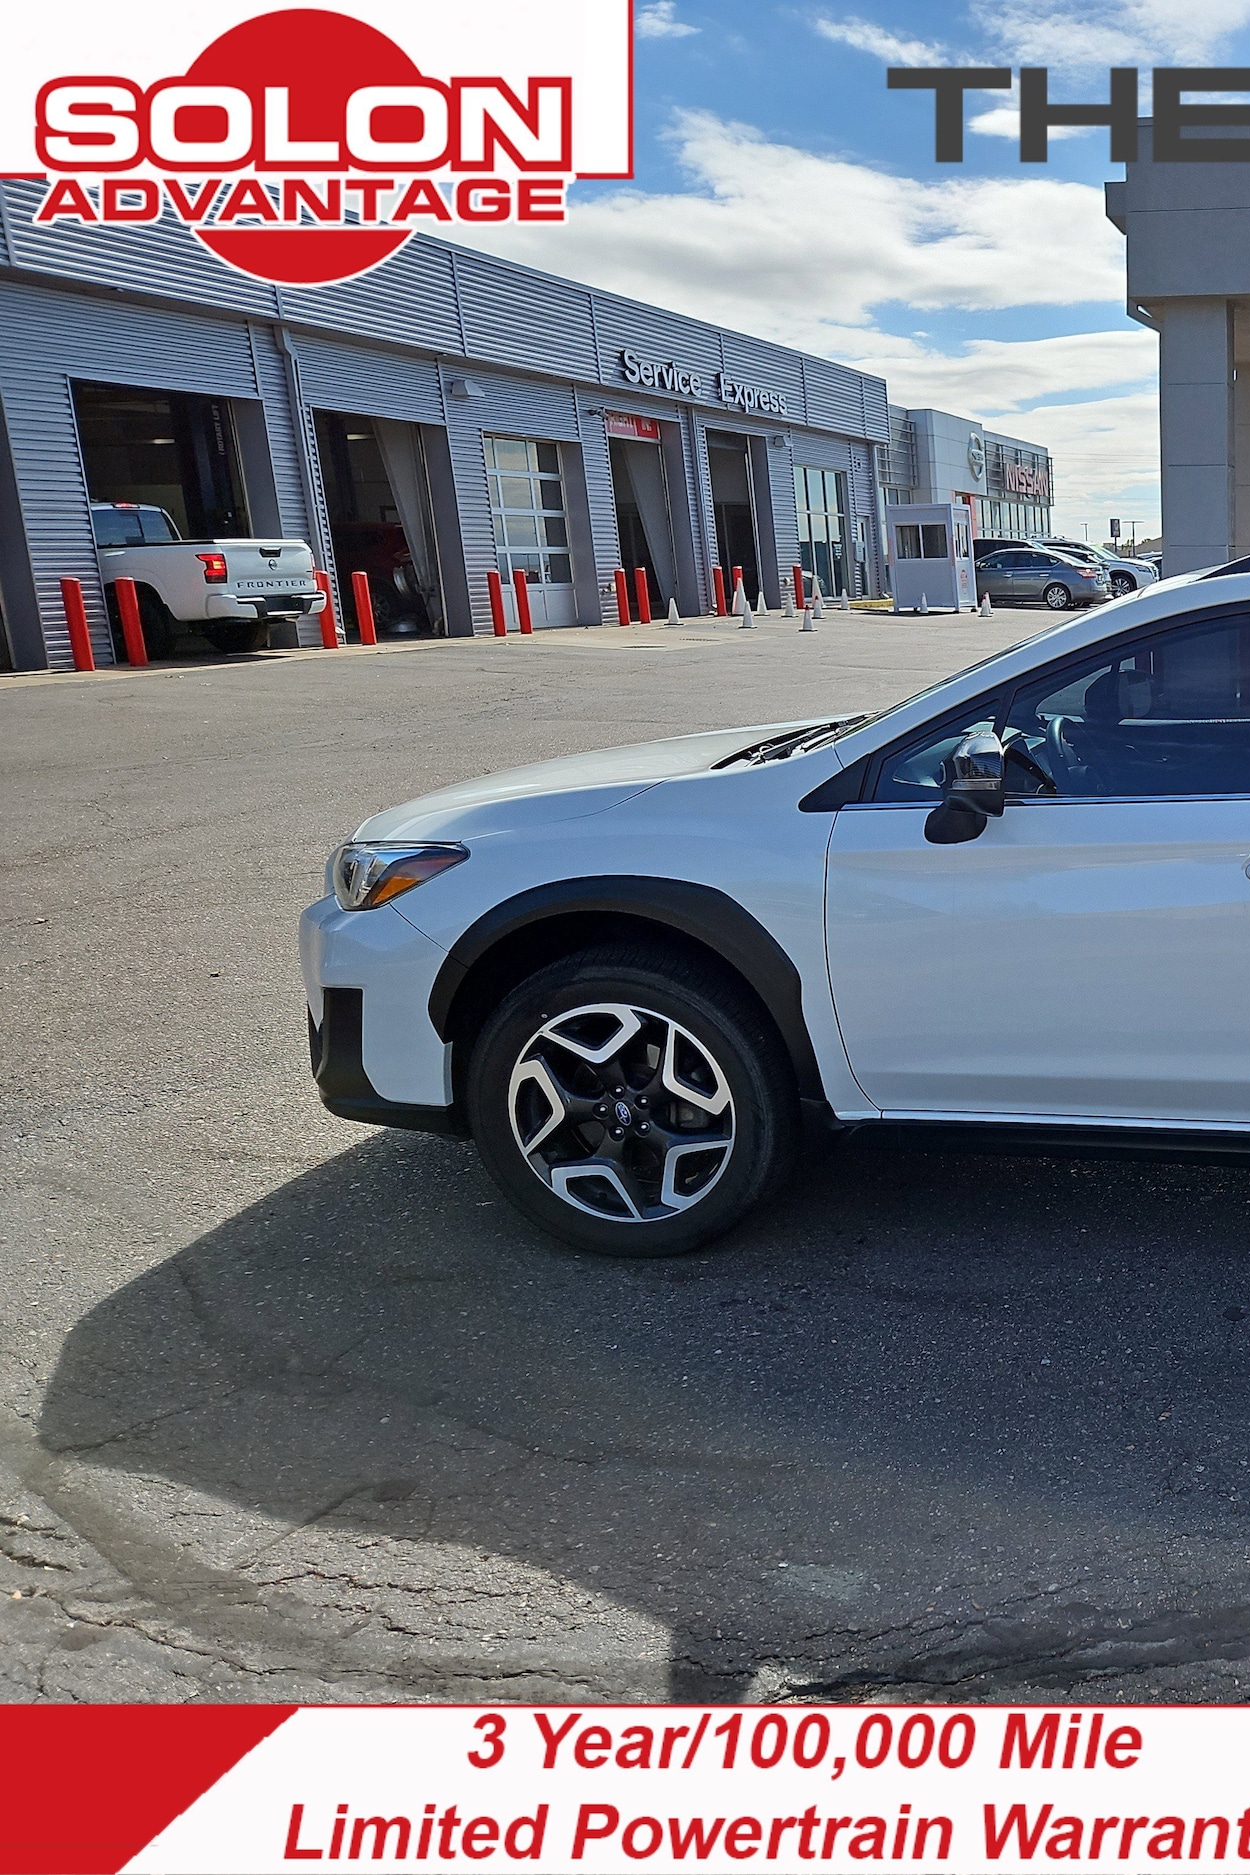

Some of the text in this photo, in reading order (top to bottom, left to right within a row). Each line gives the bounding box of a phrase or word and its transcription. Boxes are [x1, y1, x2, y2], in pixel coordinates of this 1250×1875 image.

[621, 349, 788, 415] Service Express
[1004, 462, 1049, 497] NISSAN
[236, 580, 307, 589] FRONTIER
